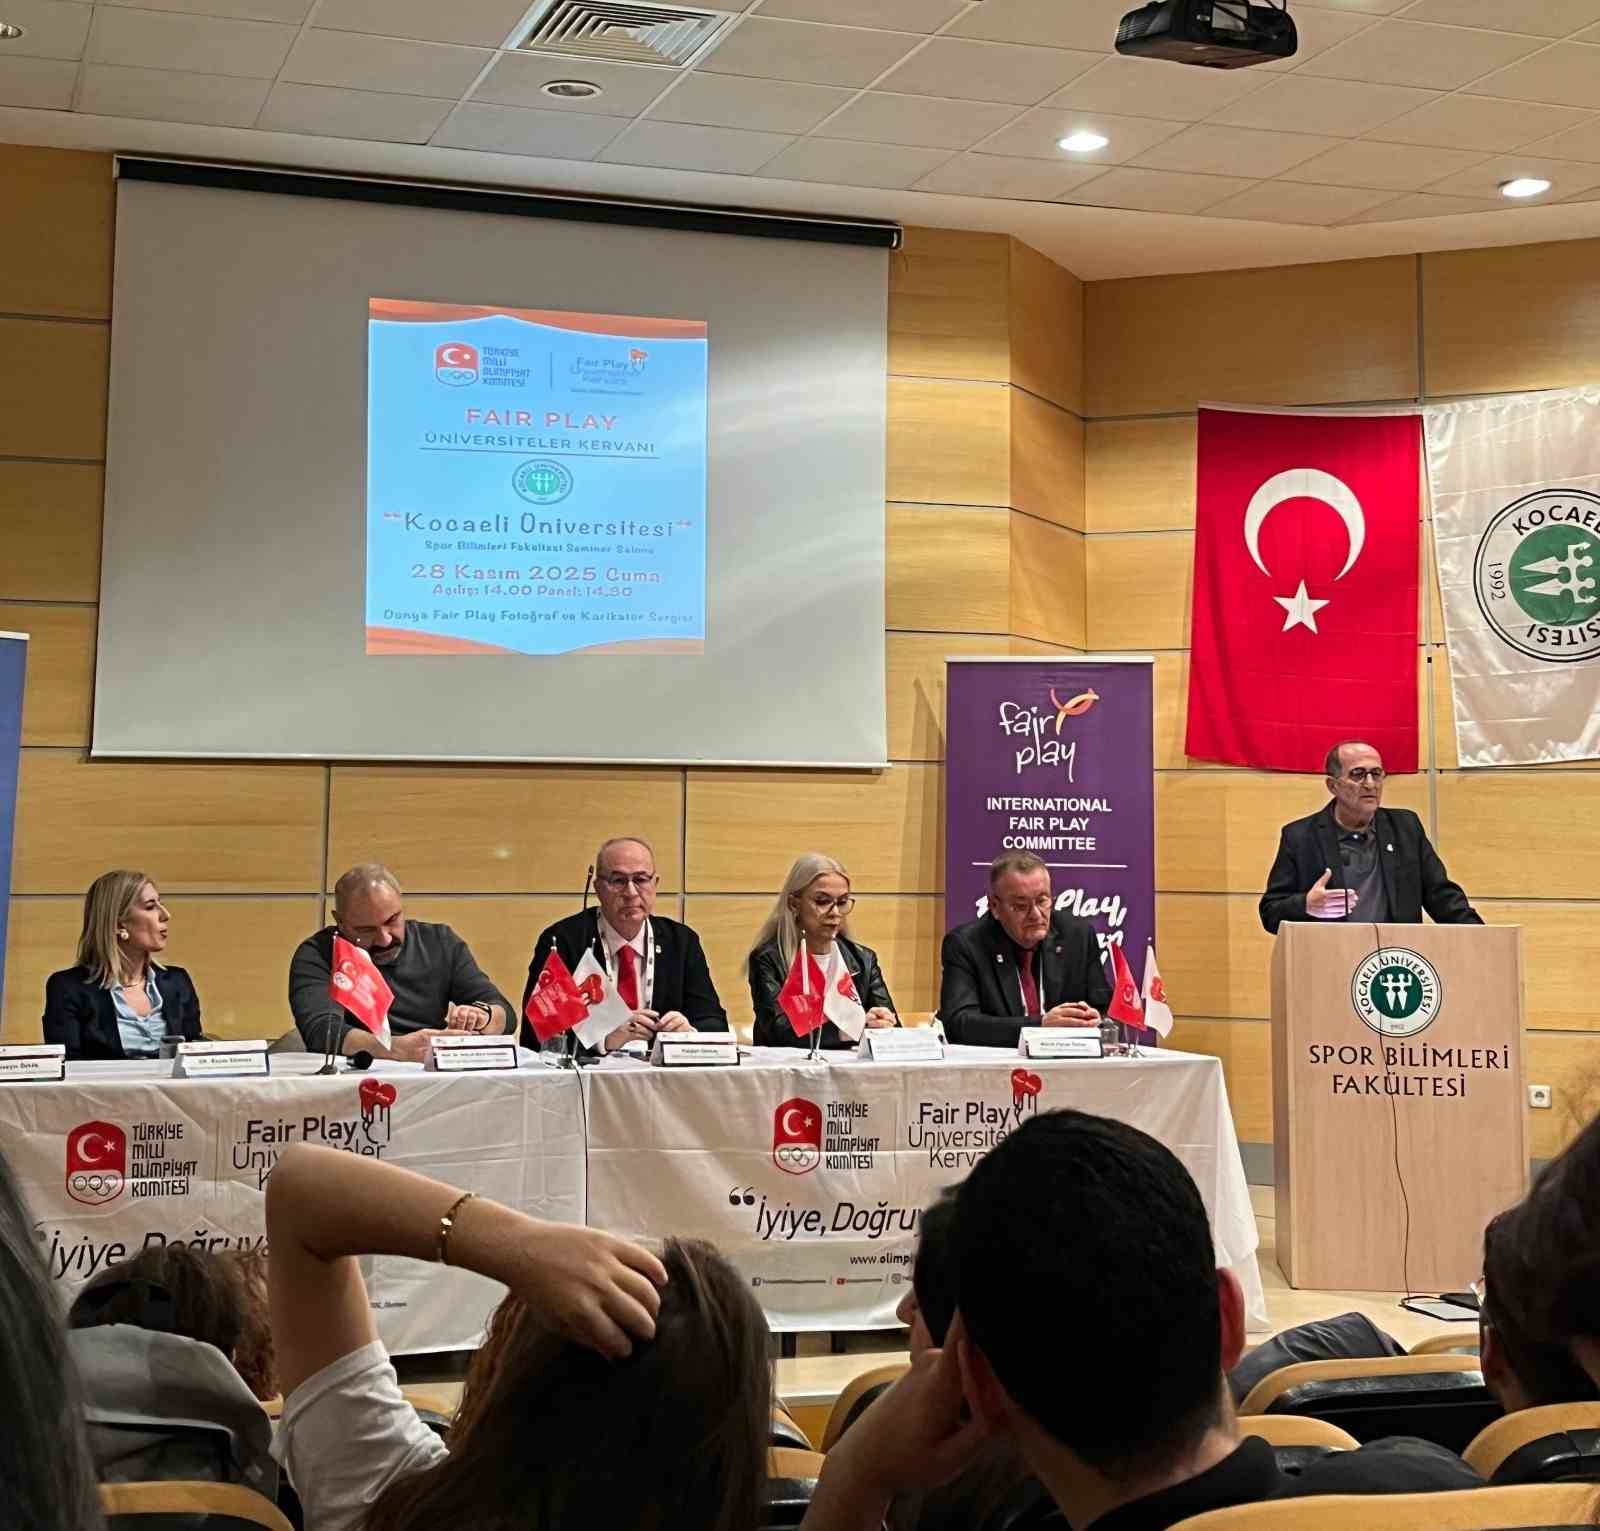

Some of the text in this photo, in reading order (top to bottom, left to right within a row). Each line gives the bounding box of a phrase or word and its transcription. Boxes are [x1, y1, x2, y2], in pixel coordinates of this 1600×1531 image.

[466, 408, 618, 432] FAIR PLAY
[578, 439, 655, 454] KERVANI
[410, 563, 446, 580] 28
[528, 566, 597, 582] 2025
[1488, 562, 1506, 600] 1992
[464, 610, 496, 623] Play
[999, 701, 1055, 738] fair
[1015, 738, 1077, 783] play
[987, 797, 1112, 812] INTERNATIONAL
[1009, 817, 1089, 831] FAIR PLAY
[1002, 836, 1096, 850] COMMITTEE
[1309, 1042, 1509, 1069] SPOR BİLİMLERİ
[1333, 1072, 1465, 1097] FAKÜLTESİ
[827, 1101, 869, 1118] TÜRKİYE
[920, 1101, 1010, 1129] Fair Play
[132, 1121, 183, 1141] TÜRKİYE
[247, 1115, 357, 1145] Fair Play
[908, 1121, 1012, 1148] Üniversite
[929, 1146, 988, 1168] Kerv
[832, 1202, 921, 1239] Doğru
